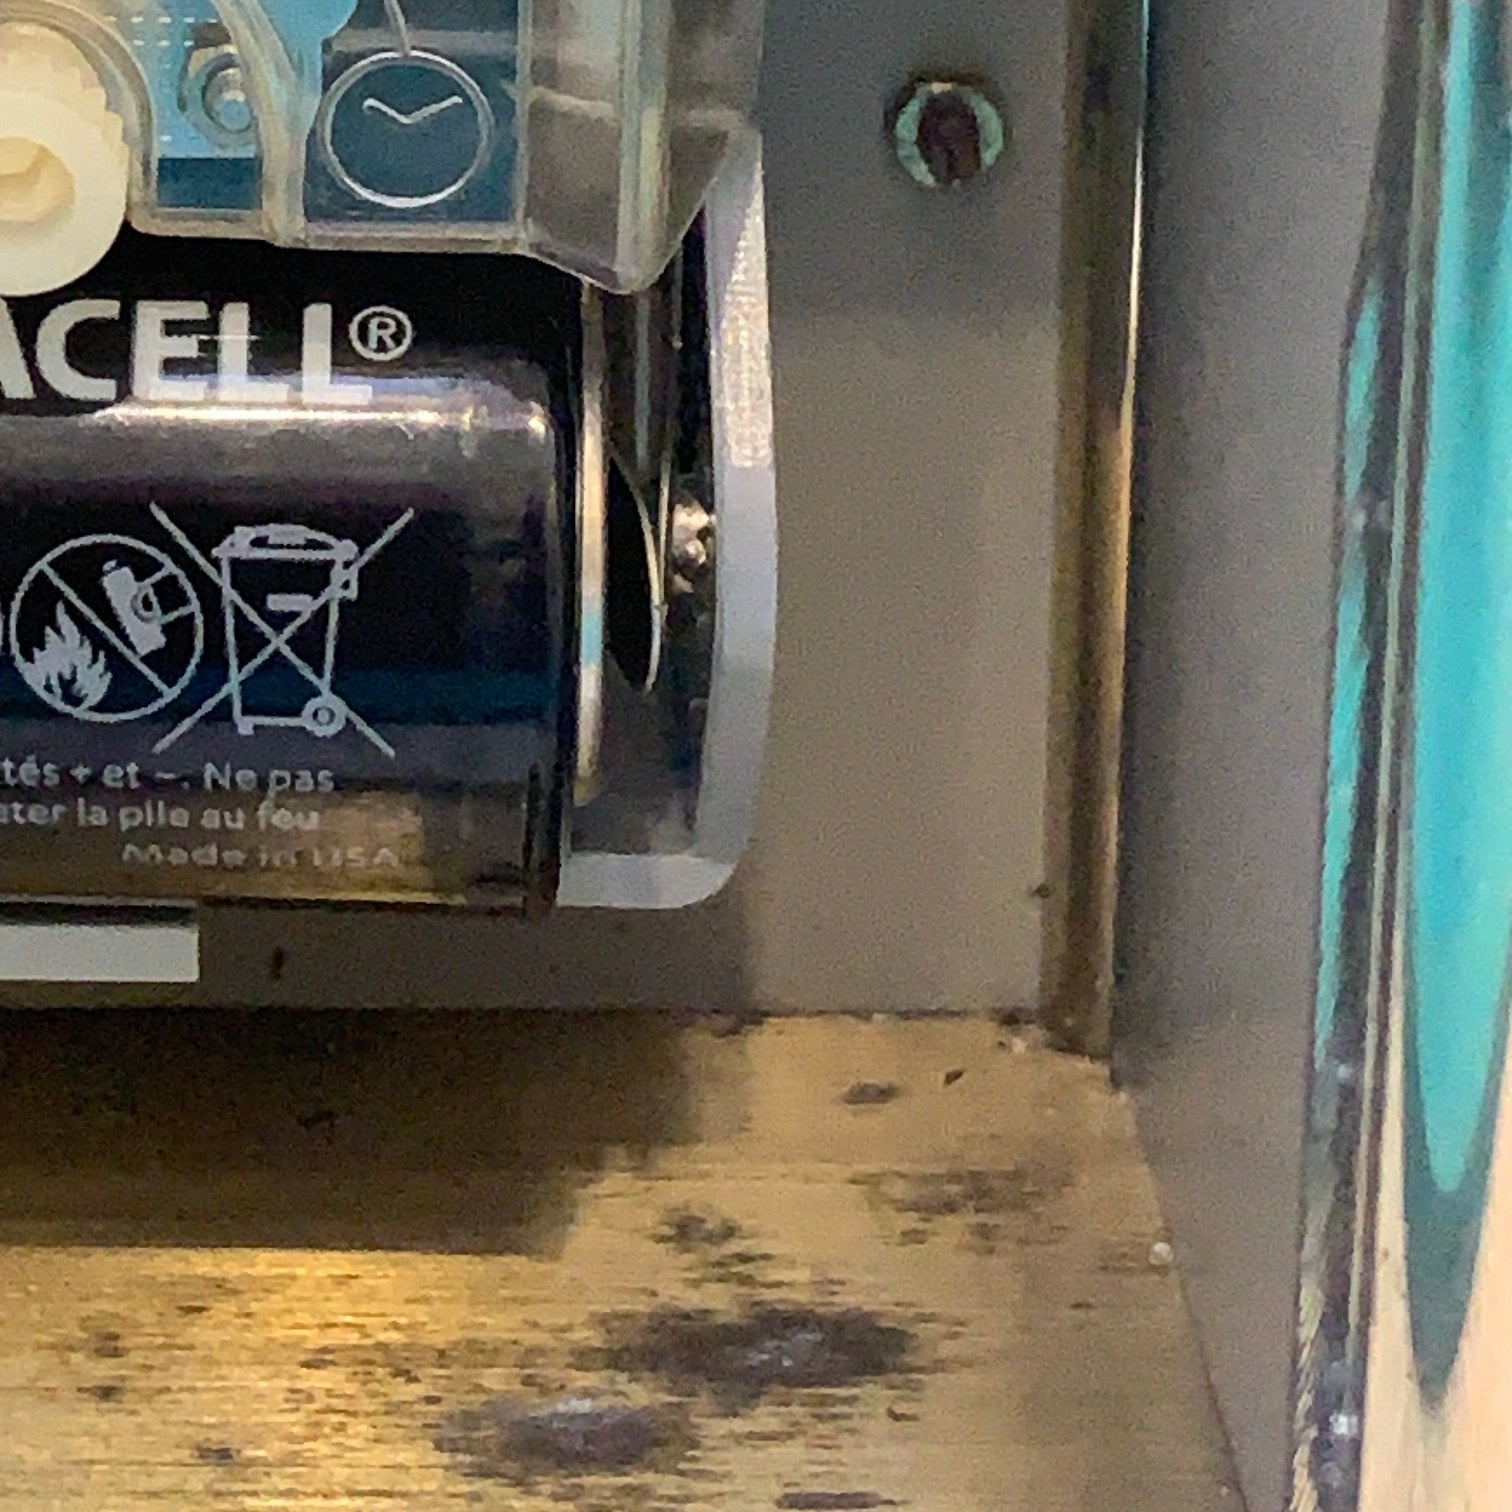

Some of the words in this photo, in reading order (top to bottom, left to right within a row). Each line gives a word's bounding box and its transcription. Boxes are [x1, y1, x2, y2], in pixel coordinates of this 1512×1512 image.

[102, 760, 140, 788] et
[203, 761, 257, 794] Ne
[269, 767, 336, 800] pas
[77, 797, 108, 828] la
[118, 799, 190, 832] pile
[200, 804, 246, 830] au
[256, 797, 320, 831] feu
[121, 842, 249, 869] Made
